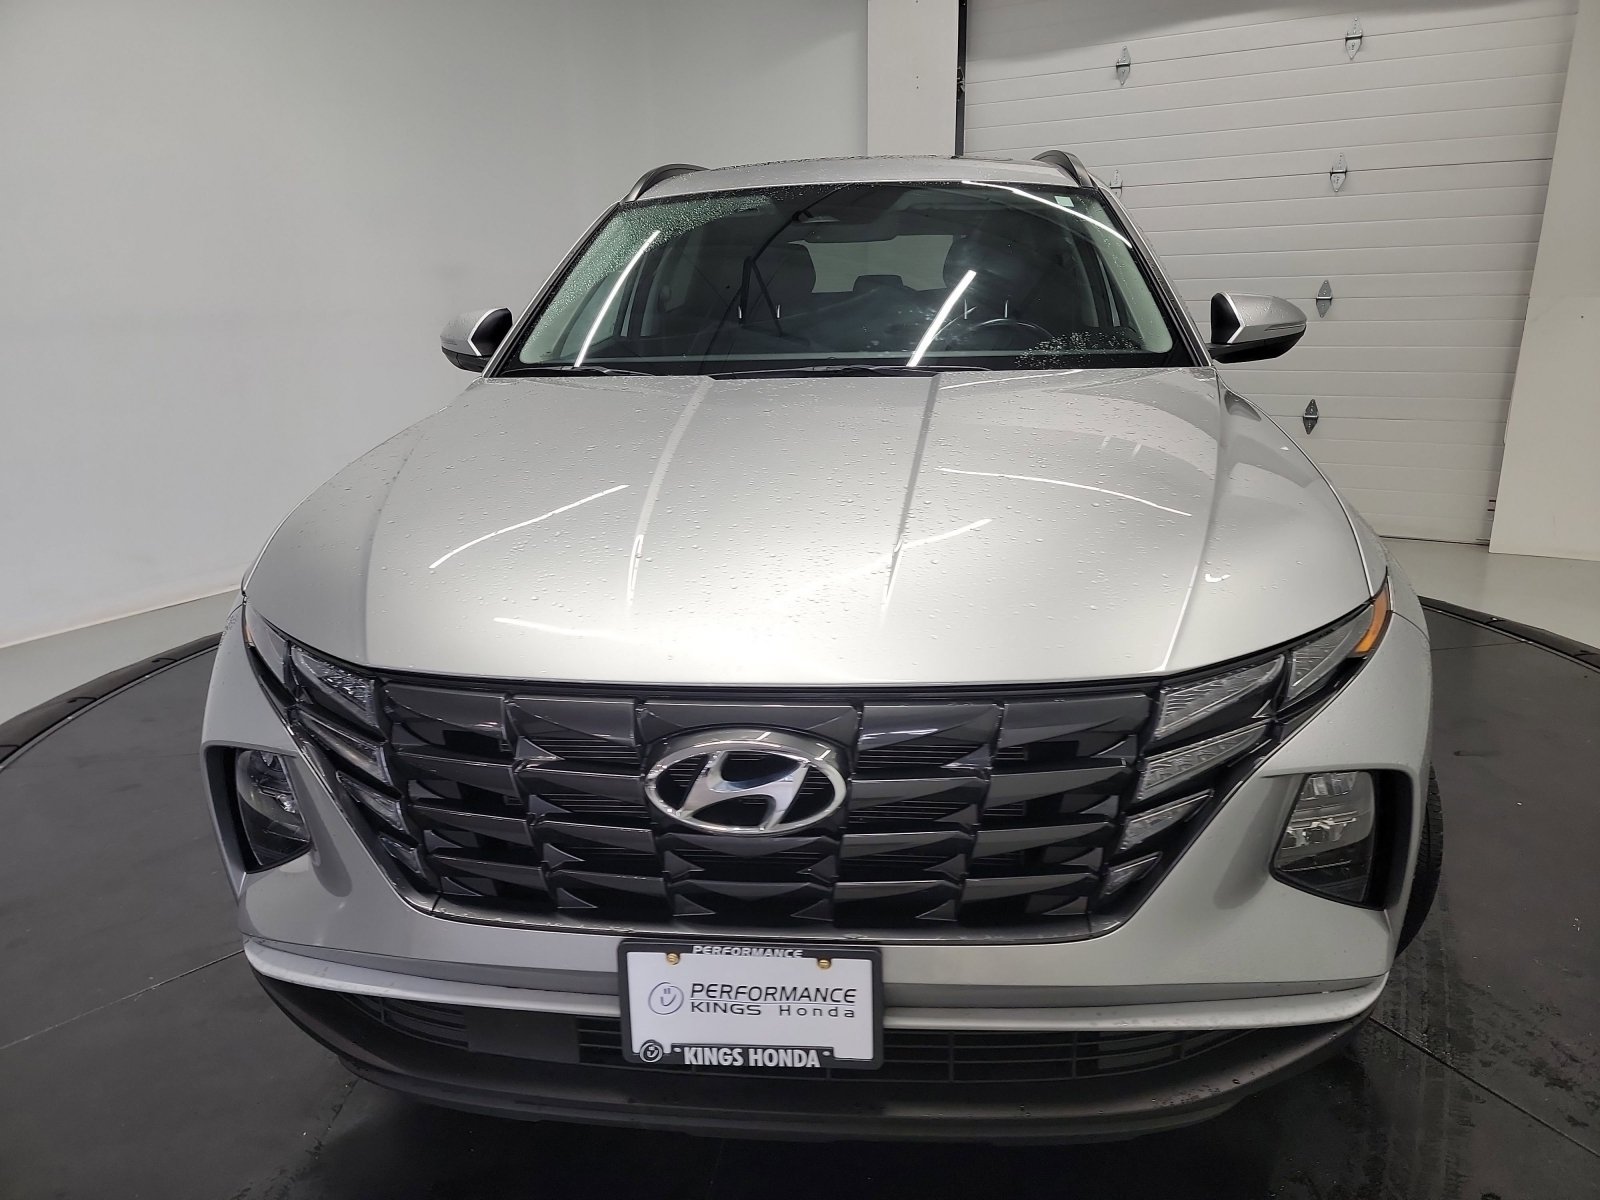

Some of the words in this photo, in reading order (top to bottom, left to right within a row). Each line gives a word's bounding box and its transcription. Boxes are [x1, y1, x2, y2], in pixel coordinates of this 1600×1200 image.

[692, 945, 803, 958] PERFORMANCE
[690, 983, 857, 1003] PERFORMANCE
[691, 1001, 762, 1016] KINGS
[779, 1005, 855, 1018] Honda
[684, 1047, 744, 1066] KINGS
[749, 1048, 821, 1068] HONDA
